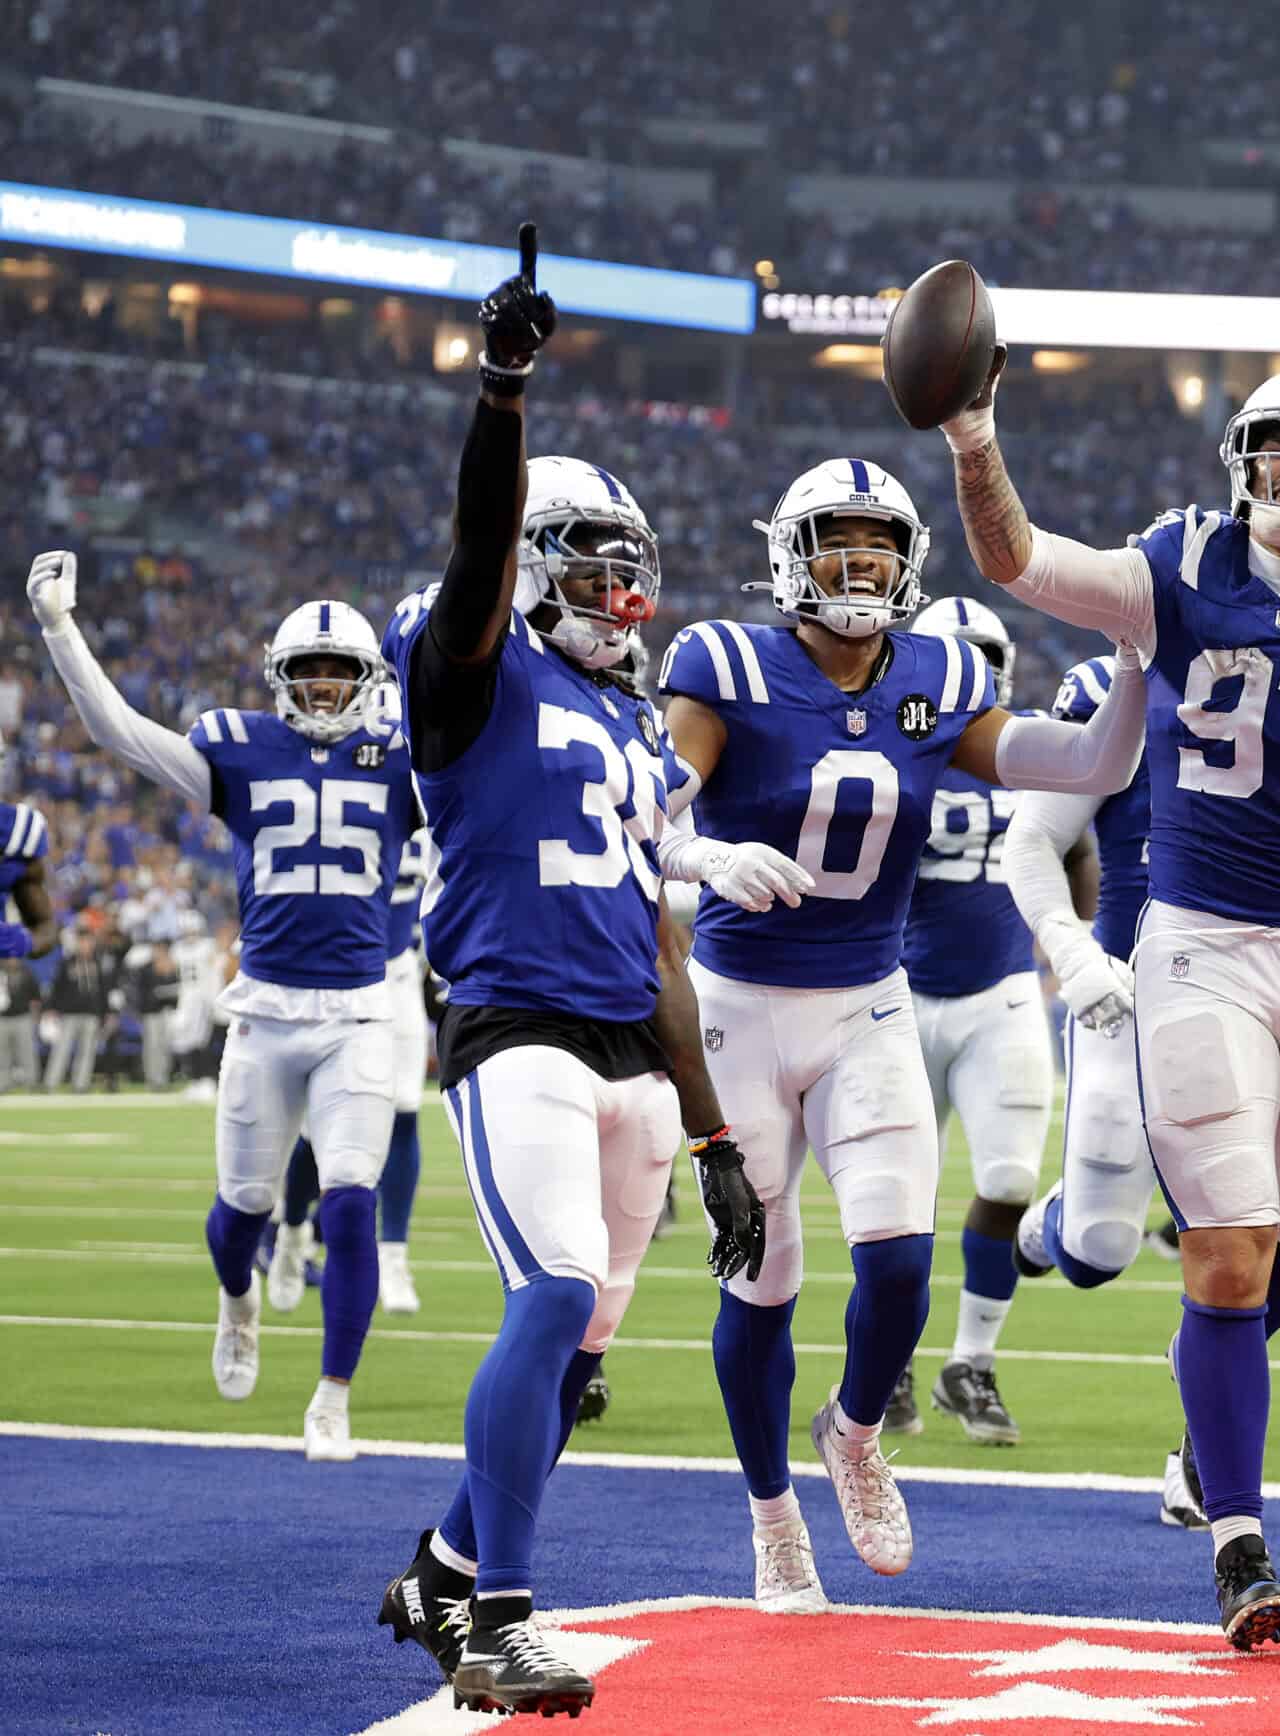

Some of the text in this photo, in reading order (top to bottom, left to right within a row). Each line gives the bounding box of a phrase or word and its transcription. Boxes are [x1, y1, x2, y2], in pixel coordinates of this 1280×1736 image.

[849, 494, 879, 503] COLTS
[249, 778, 390, 897] 25
[796, 750, 900, 901] 0
[402, 1576, 426, 1625] NIKE
